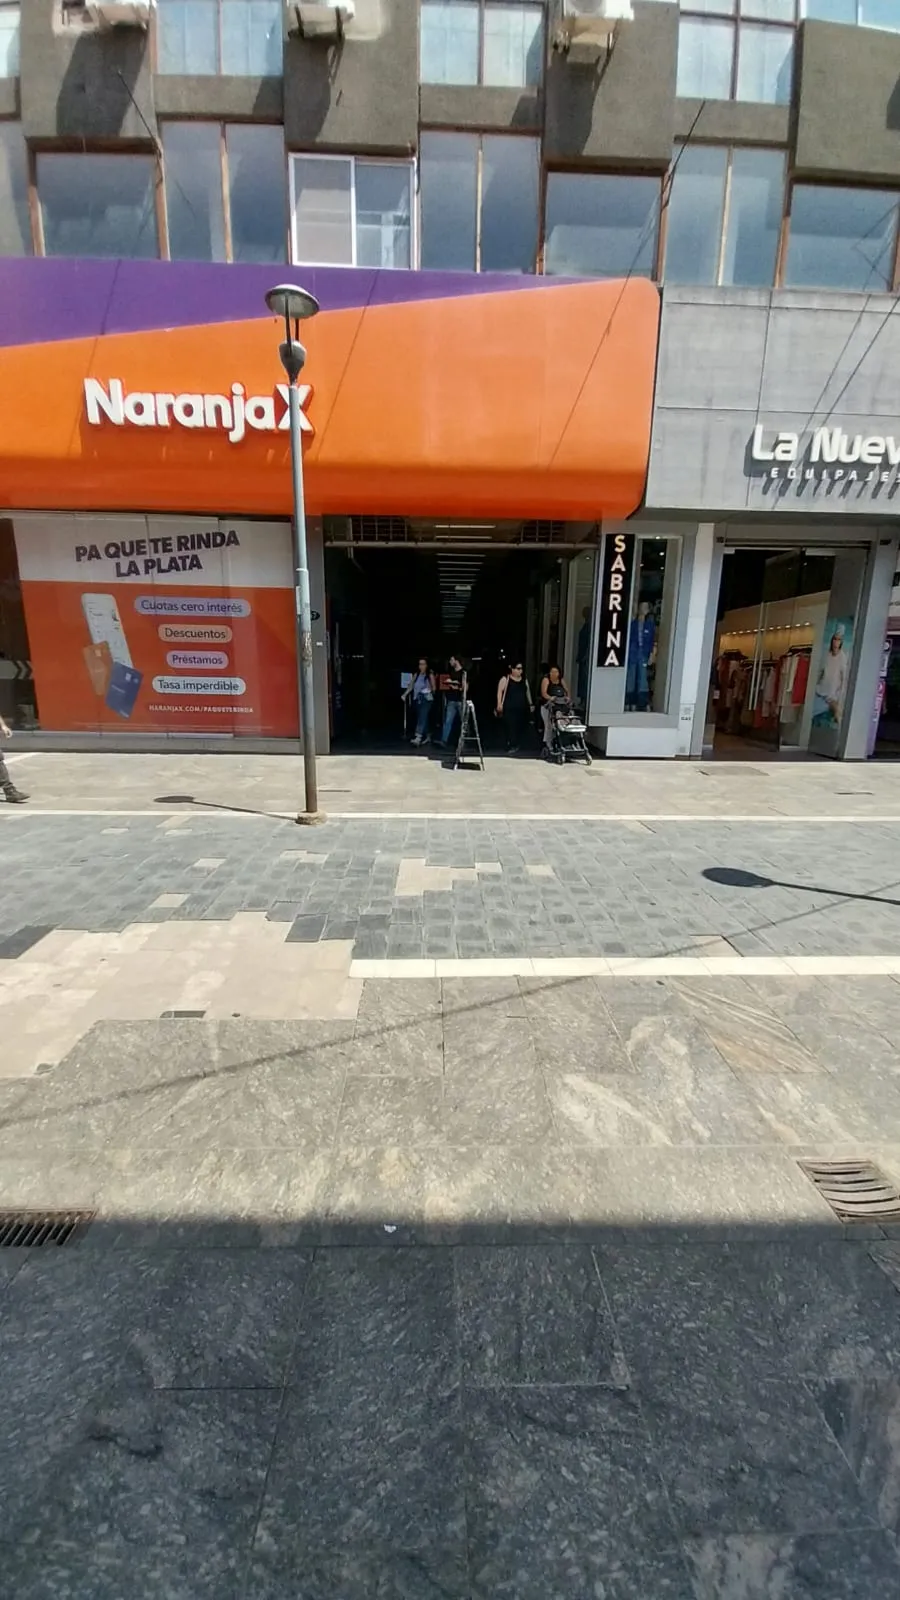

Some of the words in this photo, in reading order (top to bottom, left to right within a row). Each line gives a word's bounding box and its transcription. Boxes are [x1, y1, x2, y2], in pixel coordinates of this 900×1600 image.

[752, 423, 798, 461] La
[75, 545, 101, 562] PA
[104, 539, 147, 559] QUE
[149, 536, 173, 554] TE
[177, 530, 240, 551] RINDA
[115, 561, 140, 577] LA
[144, 554, 203, 575] PLATA
[141, 599, 178, 611] Cuotas
[181, 602, 204, 612] cero
[207, 601, 242, 613] interés
[604, 535, 626, 666] SABRINA
[165, 627, 226, 639] Descuentos
[172, 654, 223, 665] Préstamos
[157, 679, 181, 690] Tasa
[183, 679, 239, 692] imperdible
